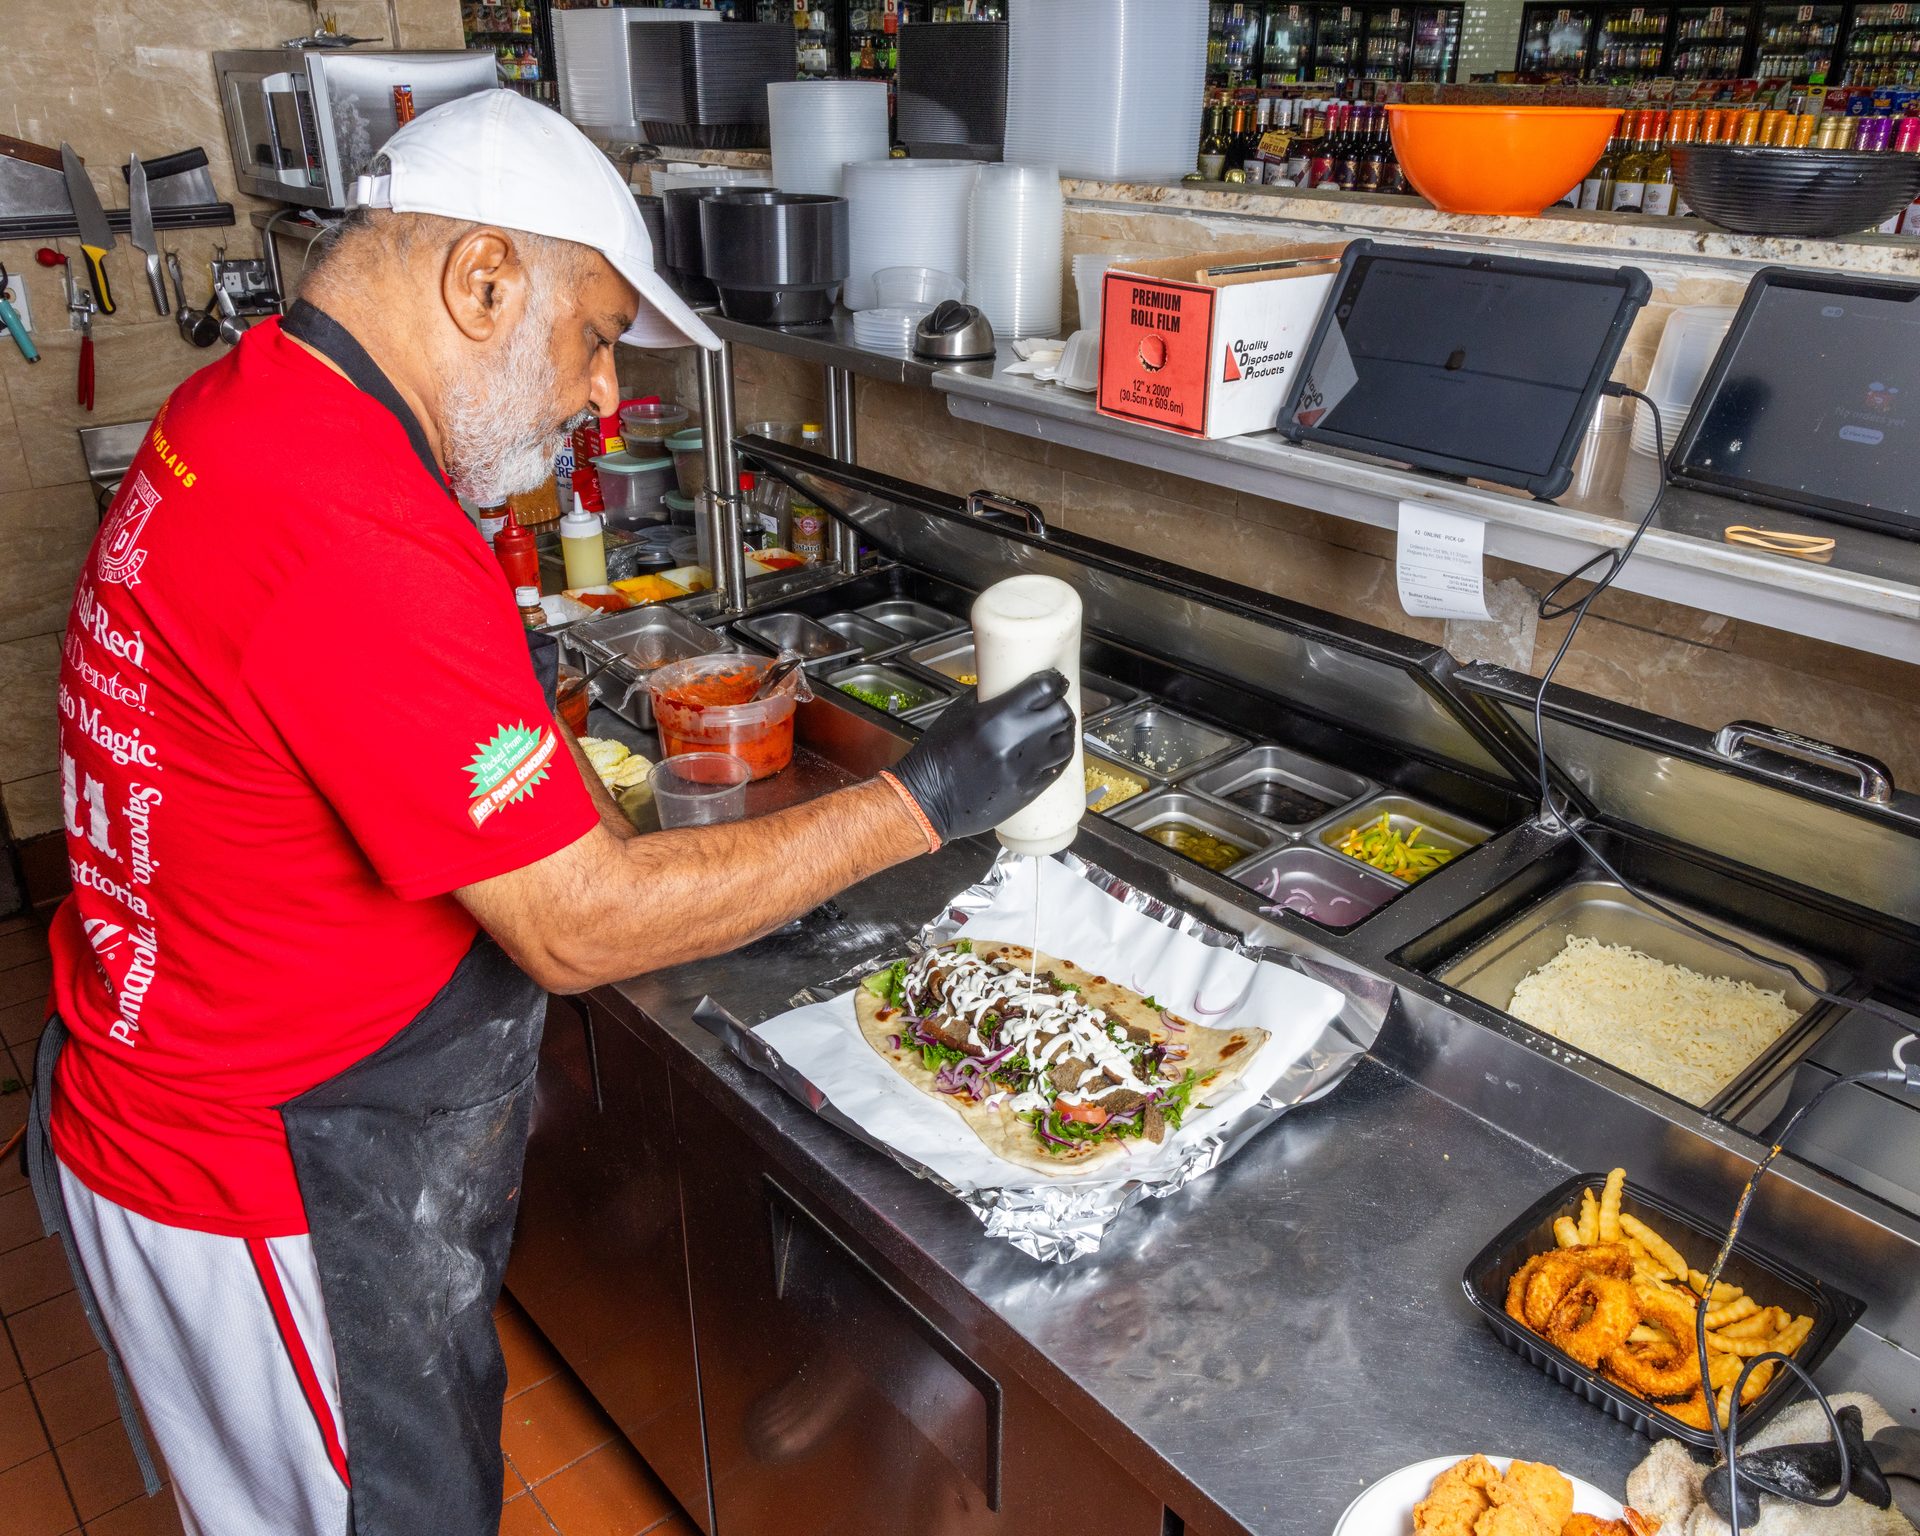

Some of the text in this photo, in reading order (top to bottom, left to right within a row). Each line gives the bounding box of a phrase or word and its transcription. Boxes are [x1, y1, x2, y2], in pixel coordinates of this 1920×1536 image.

[887, 0, 895, 12] 6
[966, 0, 974, 13] 7
[1632, 9, 1643, 21] 17
[1711, 8, 1722, 20] 18
[1801, 6, 1812, 20] 19
[1892, 4, 1905, 18] 20
[1559, 11, 1568, 23] 16
[1132, 288, 1182, 312] PREMIUM
[1131, 309, 1181, 333] ROLL FILM
[1234, 339, 1268, 354] Quality
[1239, 349, 1293, 367] Disposable
[1245, 366, 1285, 380] Products
[1132, 379, 1145, 392] 12"
[1152, 383, 1172, 397] 2000'
[1119, 389, 1148, 405] (30.5cm
[1154, 397, 1184, 417] 609.6m)
[1423, 531, 1442, 540] ONLINE
[108, 555, 143, 580] QUALITY
[1423, 594, 1443, 602] Chicken
[69, 633, 148, 712] Dente!
[79, 697, 157, 767] Magic
[480, 735, 523, 774] Packed From
[482, 736, 535, 787] Fresh Tomatoes!
[472, 731, 556, 821] NOT FROM CONCENTRATE
[122, 783, 163, 885] Saporito
